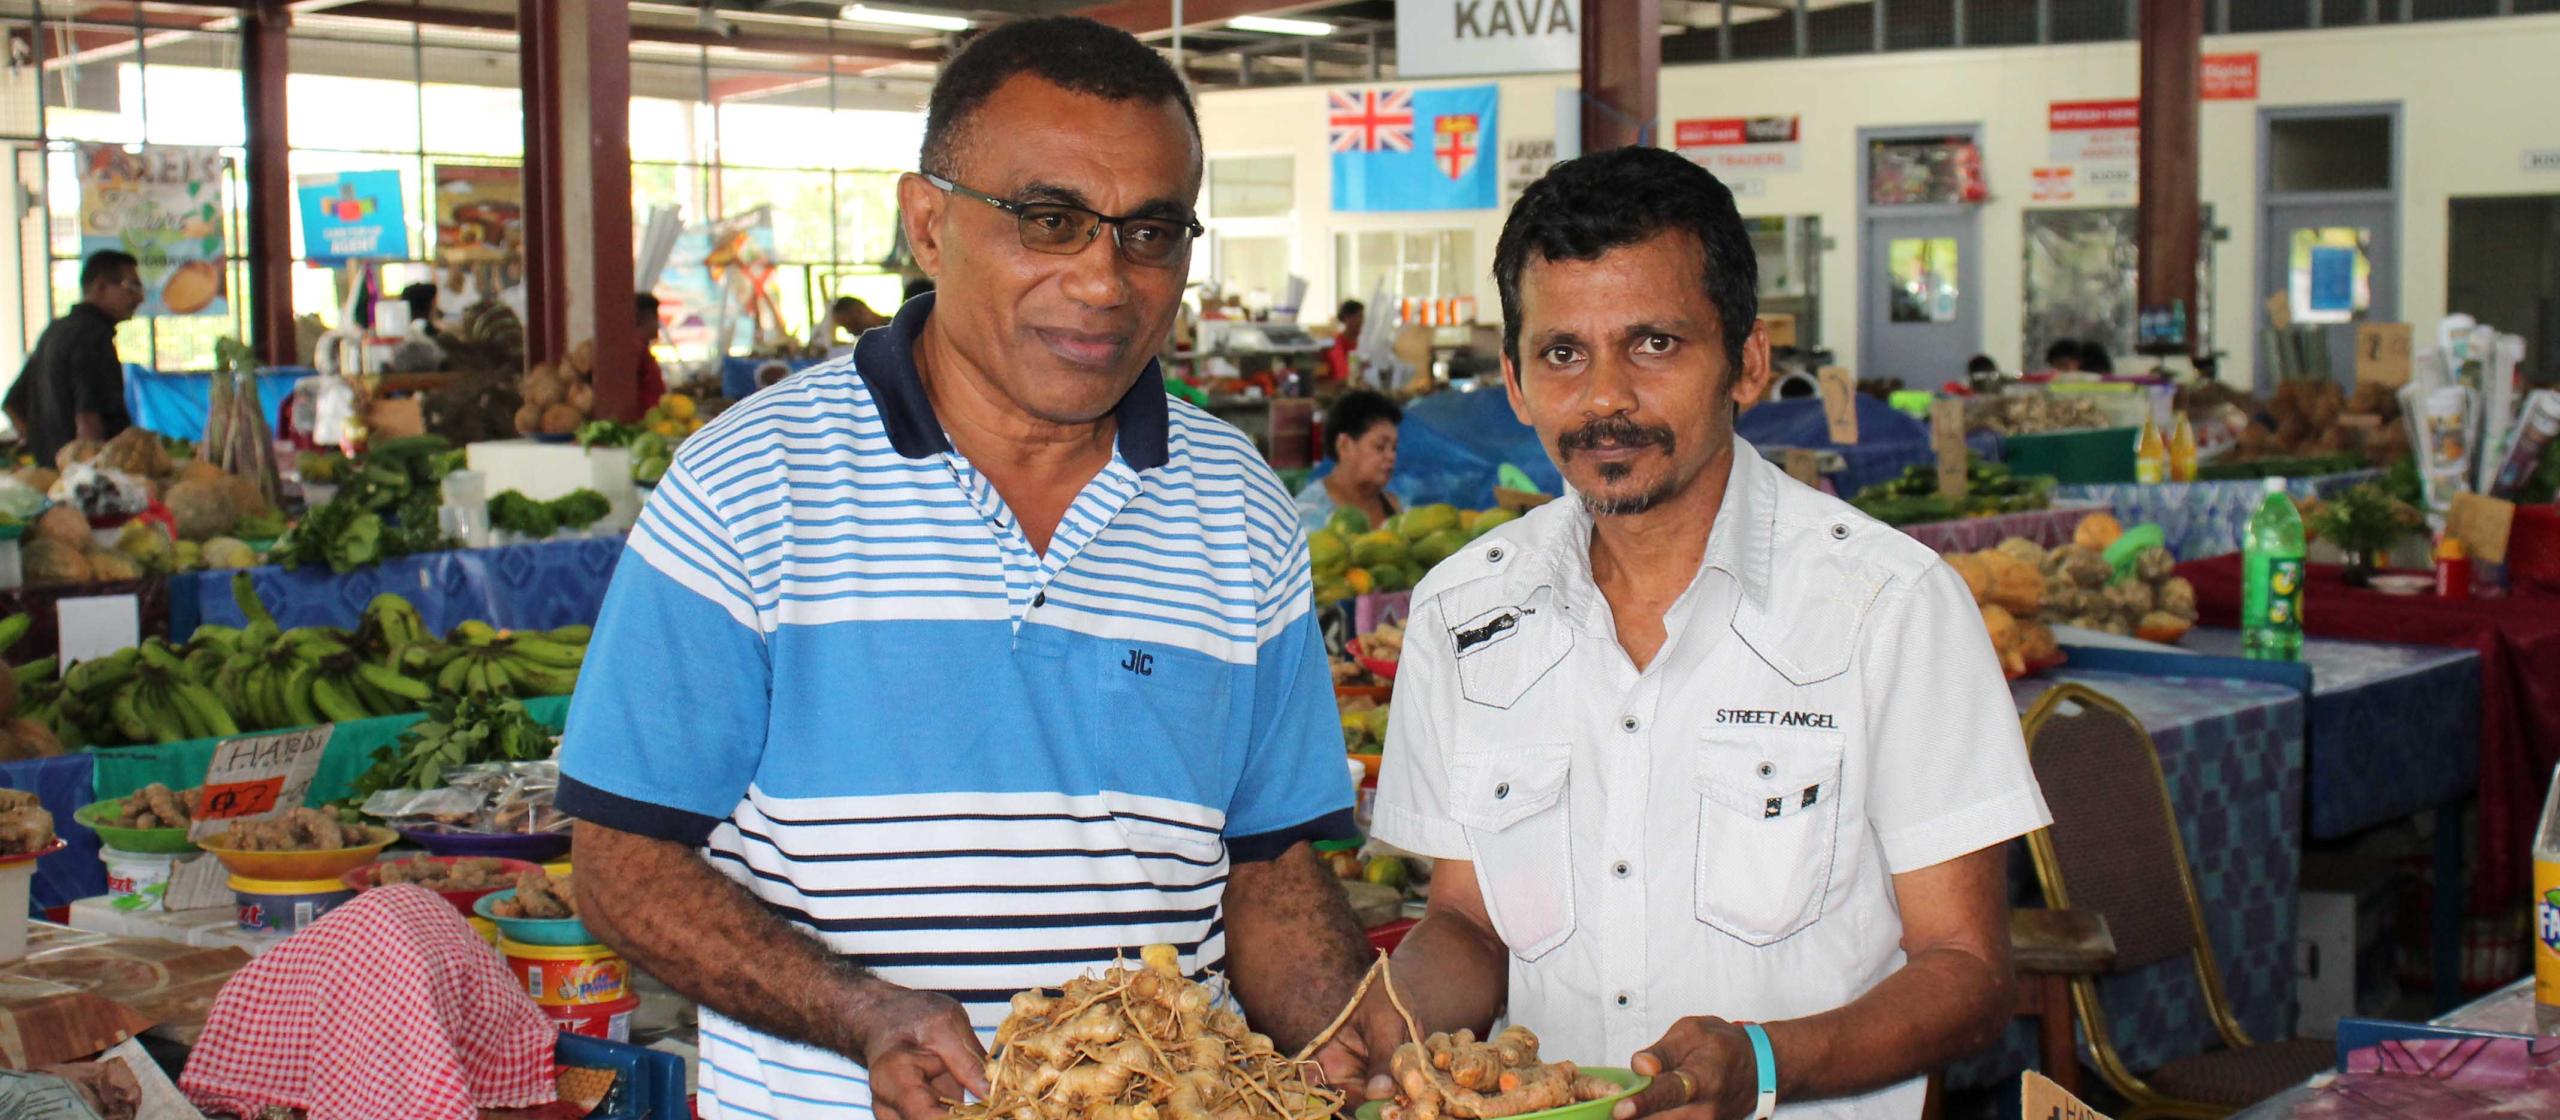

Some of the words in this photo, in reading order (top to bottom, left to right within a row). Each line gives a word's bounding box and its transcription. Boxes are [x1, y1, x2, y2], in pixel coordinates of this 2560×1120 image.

[1454, 0, 1575, 38] KAVA
[1715, 708, 1779, 724] STREET
[1780, 711, 1839, 729] ANGEL
